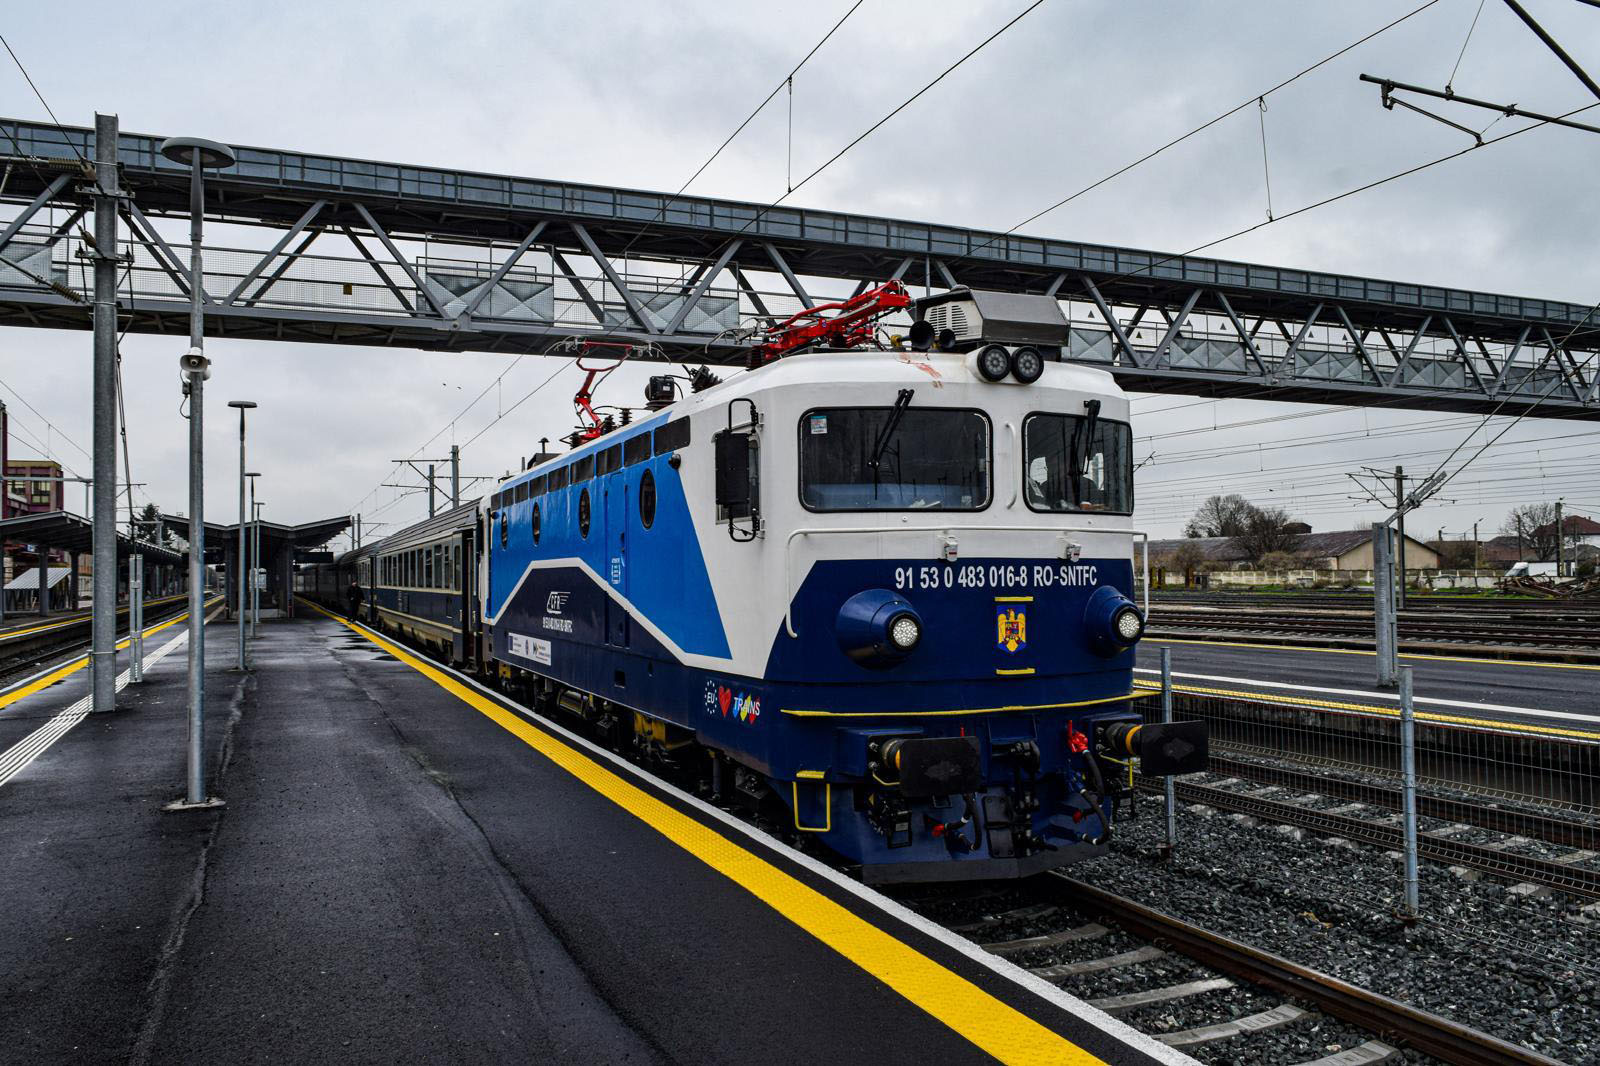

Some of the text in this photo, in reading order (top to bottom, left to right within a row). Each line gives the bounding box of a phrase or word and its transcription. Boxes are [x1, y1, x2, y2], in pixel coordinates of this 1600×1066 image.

[895, 565, 1098, 589] 91 53 0 483 016-8 RO-SNTFC
[707, 691, 715, 704] EU
